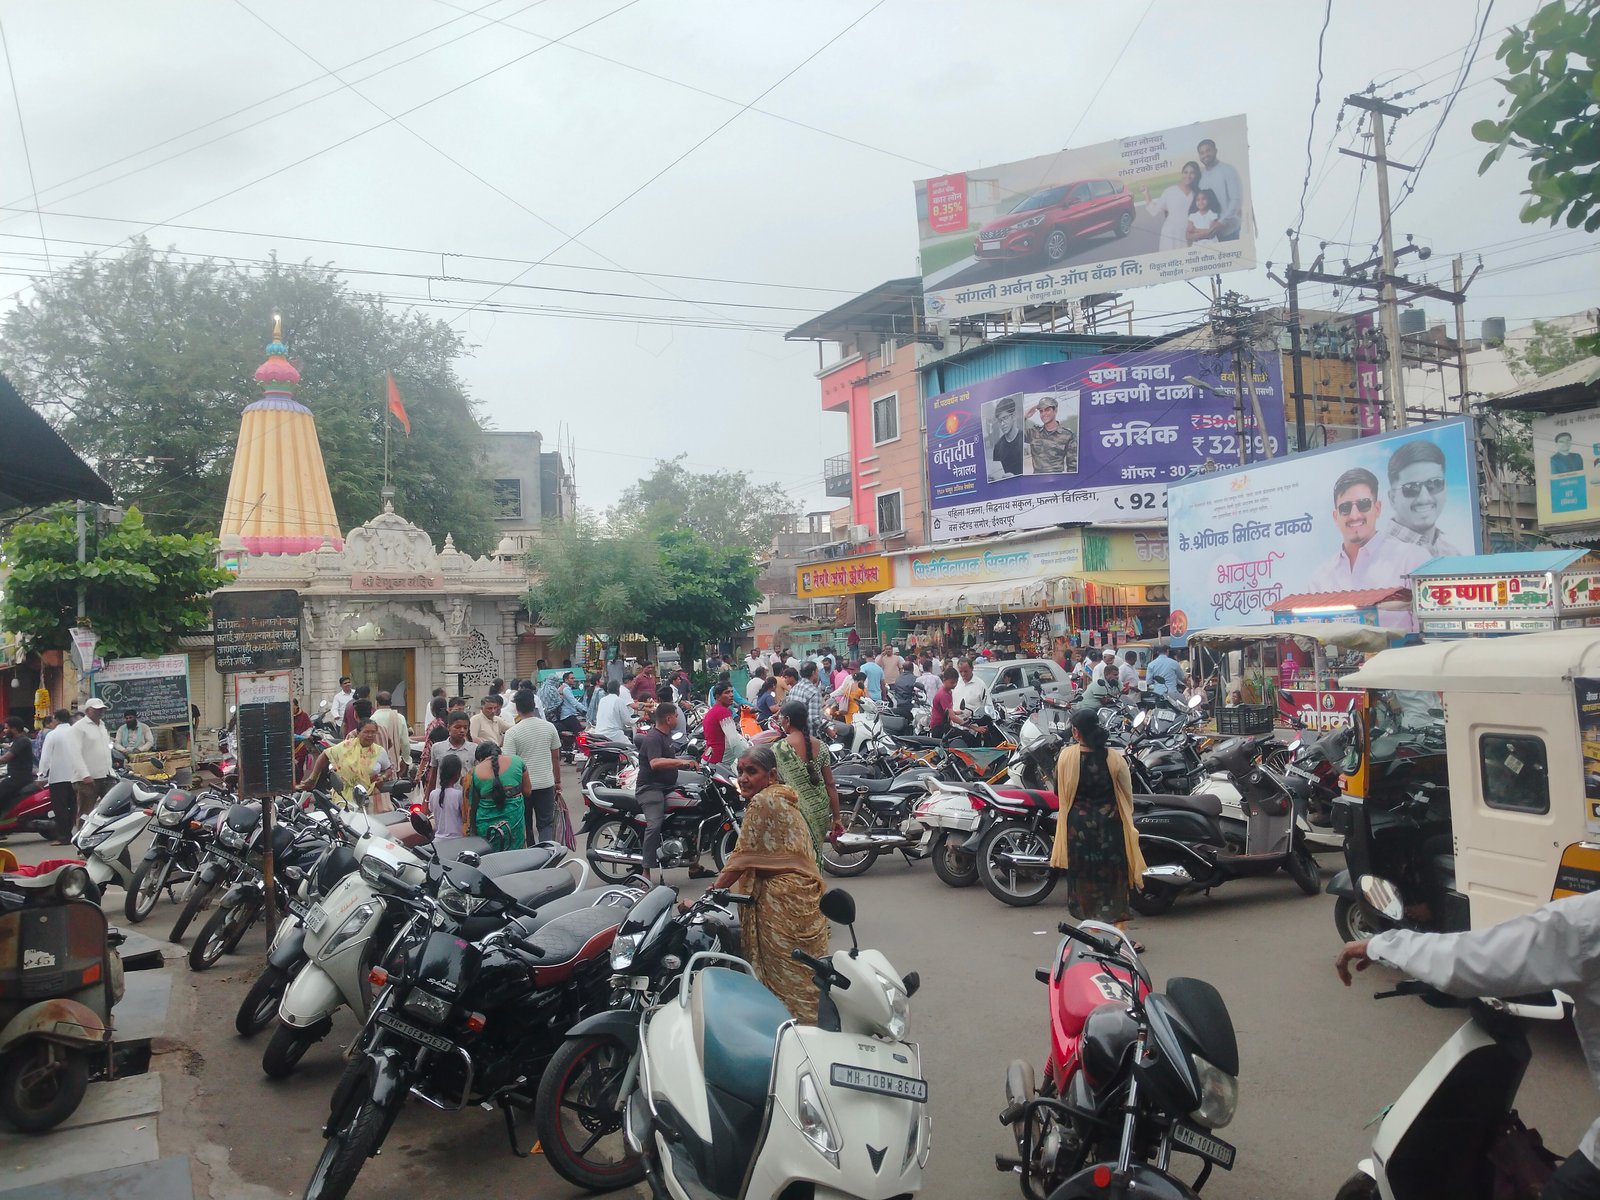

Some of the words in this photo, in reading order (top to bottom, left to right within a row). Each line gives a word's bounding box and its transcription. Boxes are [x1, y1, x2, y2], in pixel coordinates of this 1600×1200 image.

[933, 201, 963, 216] 8.35%
[955, 284, 997, 304] सांगली
[999, 278, 1032, 296] अर्बन
[1092, 264, 1117, 280] बँक
[1089, 366, 1128, 385] चष्मा
[1131, 364, 1175, 382] काढा,
[1091, 383, 1151, 406] अडचणी
[952, 463, 977, 478] नेत्रालय
[1121, 465, 1157, 479] ऑफर
[1170, 465, 1186, 477] 30
[947, 506, 965, 518] पहिला
[1129, 492, 1156, 510] 92
[1232, 519, 1272, 544] मिलिंद
[1274, 512, 1314, 537] टाकळे
[1427, 583, 1496, 606] कृष्णा
[857, 1043, 876, 1053] TVS
[846, 1070, 860, 1084] MH
[866, 1074, 893, 1090] 10BW
[897, 1080, 923, 1098] 8644
